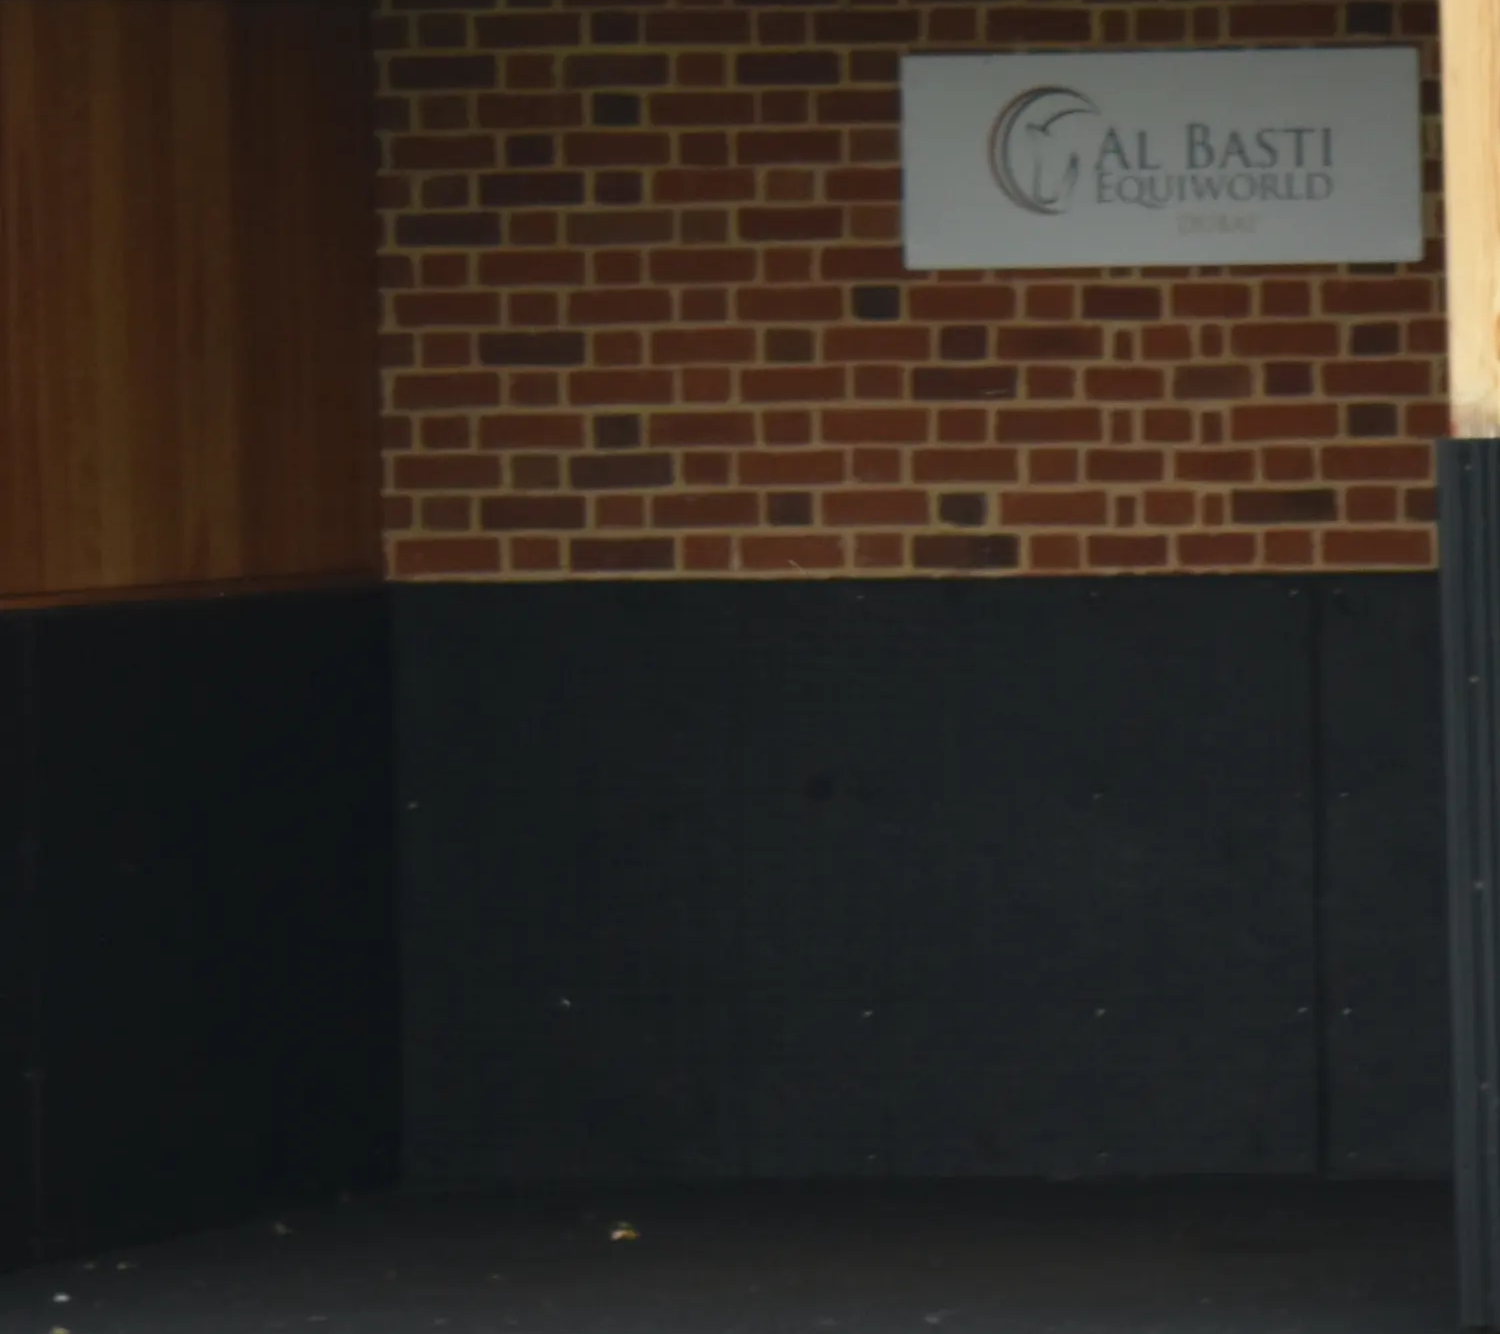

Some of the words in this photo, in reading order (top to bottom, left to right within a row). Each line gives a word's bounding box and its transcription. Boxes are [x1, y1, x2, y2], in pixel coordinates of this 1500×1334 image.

[1095, 127, 1162, 170] AL
[1185, 123, 1332, 169] BASTI
[1096, 171, 1334, 209] EQUIWORLD
